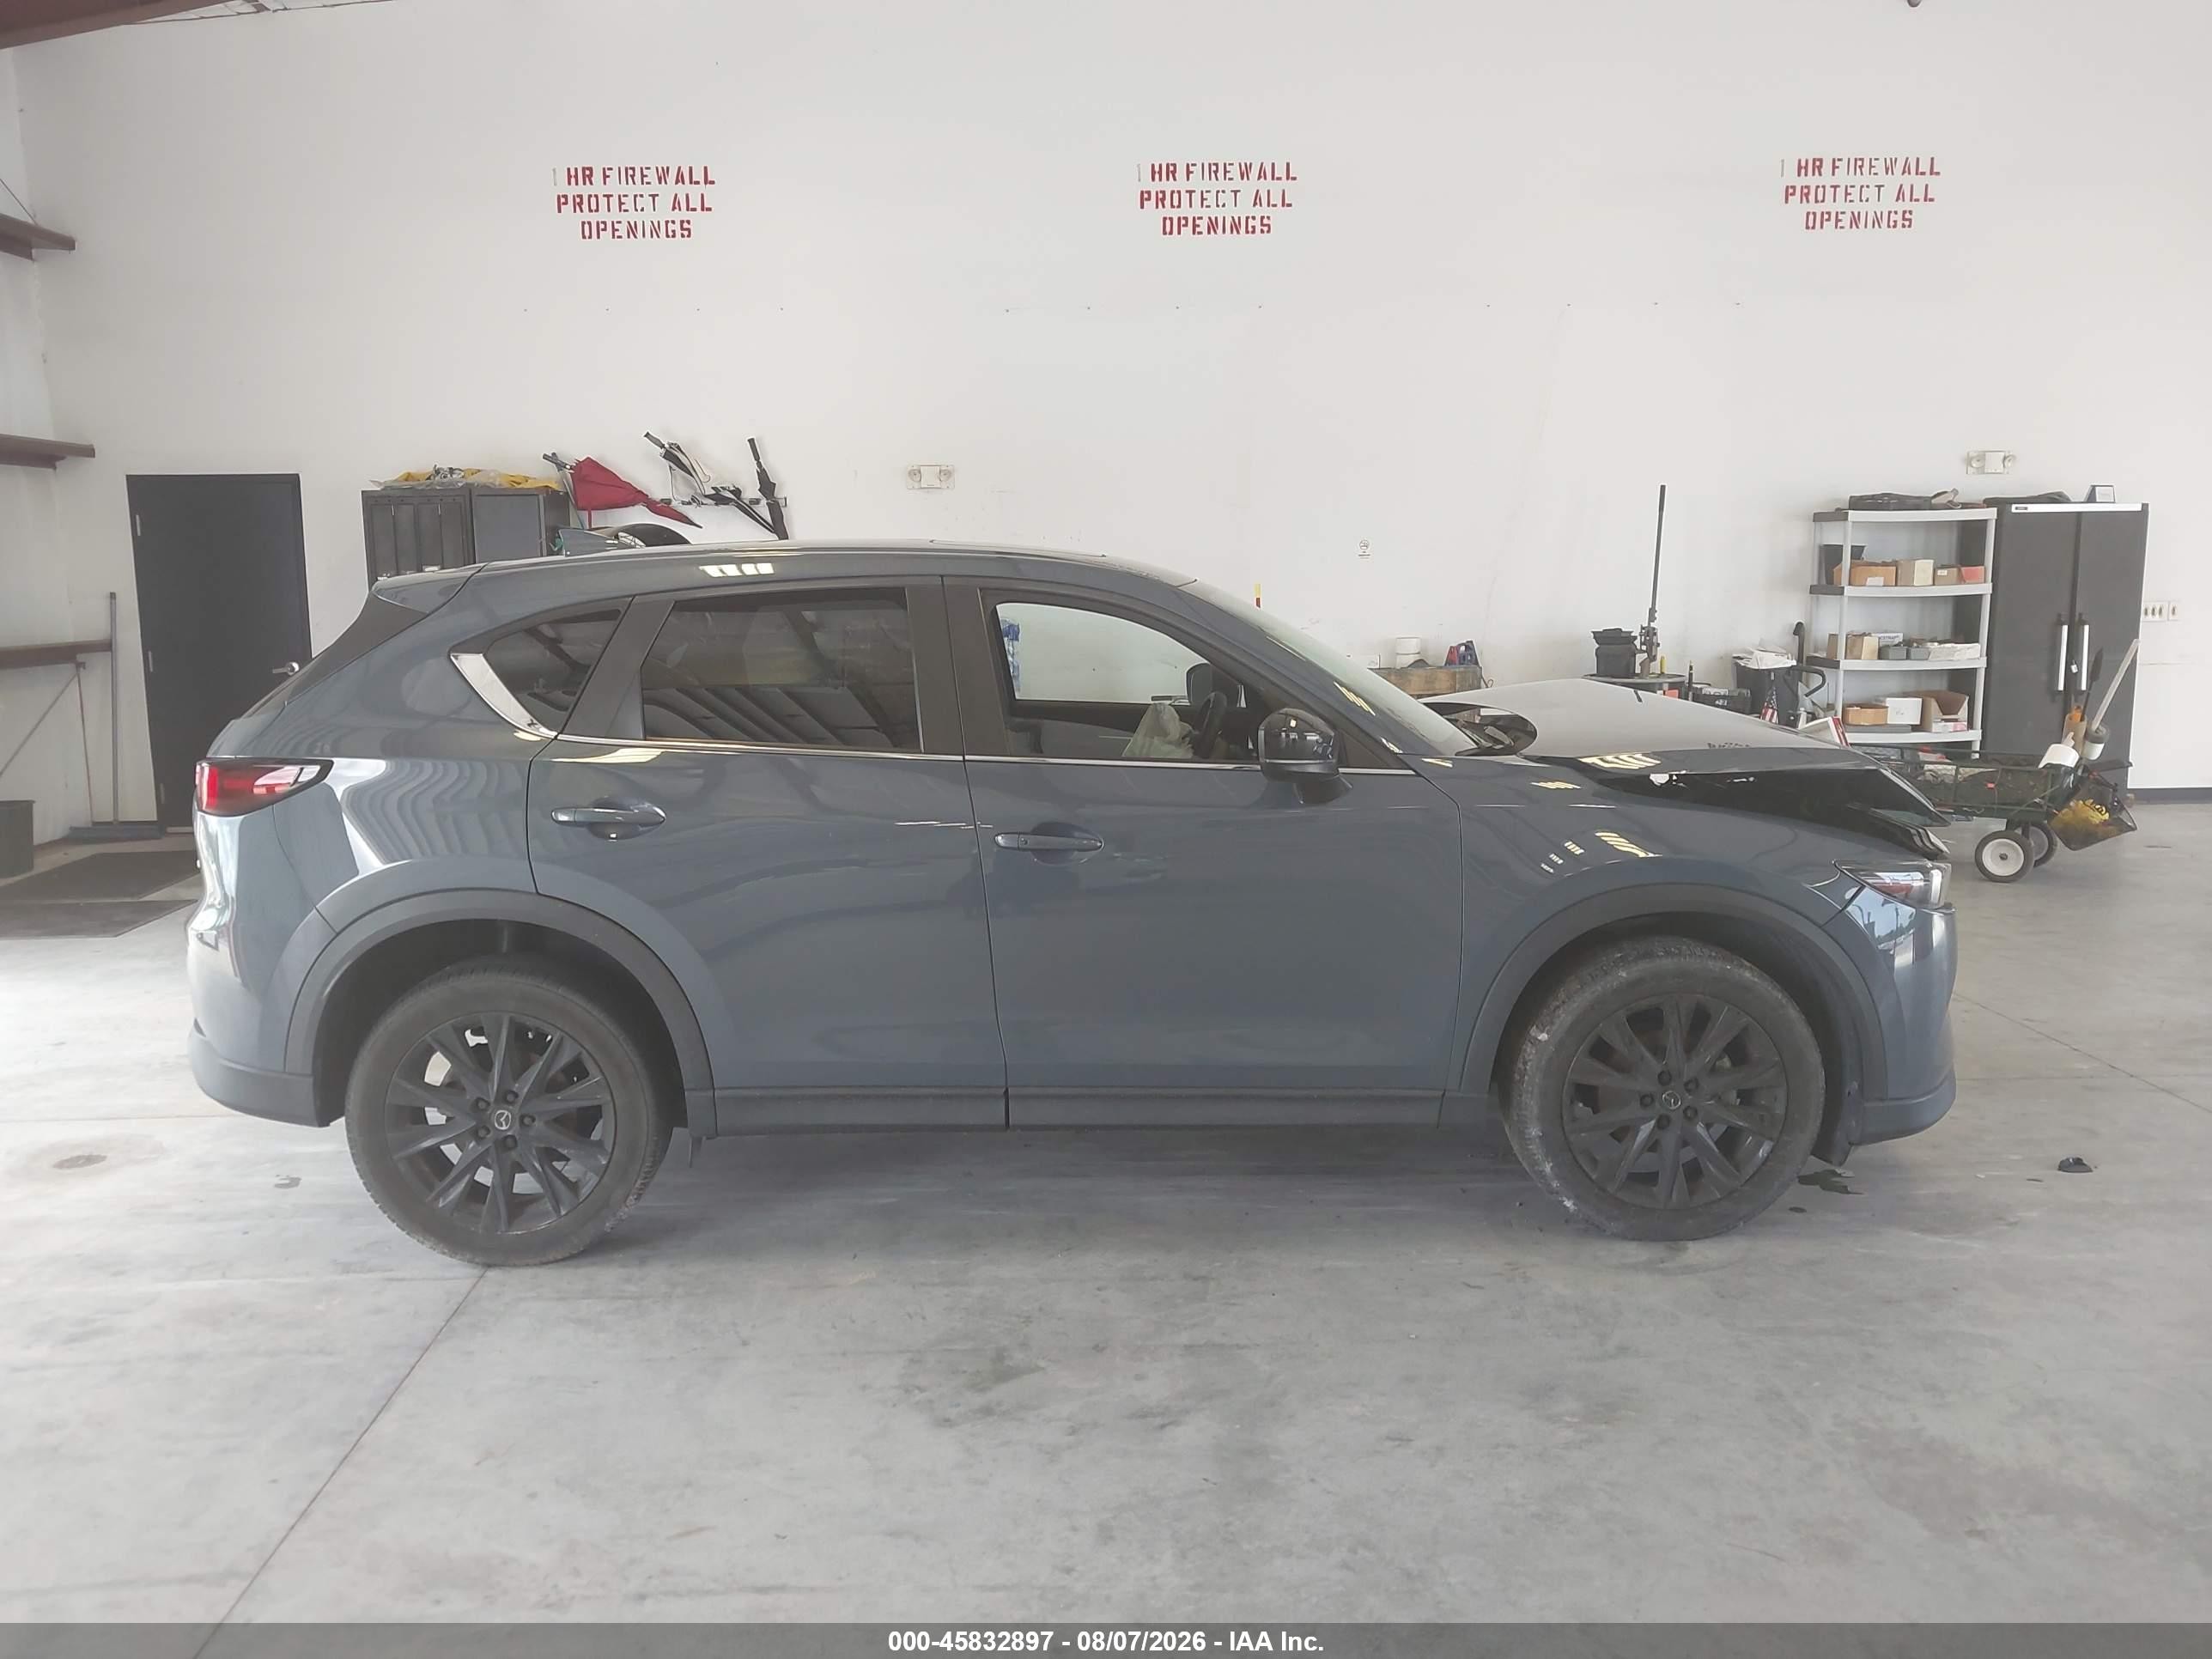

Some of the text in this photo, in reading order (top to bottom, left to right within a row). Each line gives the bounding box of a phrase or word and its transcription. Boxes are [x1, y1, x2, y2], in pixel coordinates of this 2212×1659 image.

[567, 167, 593, 185] HR
[603, 166, 715, 185] FIREWALL
[1152, 162, 1176, 182] HR
[1186, 162, 1297, 181] FIREWALL
[1797, 158, 1823, 177] HR
[1832, 157, 1941, 176] FIREWALL
[557, 193, 712, 213] PROTECT ALL
[1140, 189, 1292, 210] PROTECT ALL
[1785, 184, 1935, 204] PROTECT ALL
[581, 220, 691, 240] OPENINGS
[1163, 216, 1271, 235] OPENINGS
[1805, 210, 1913, 230] OPENINGS
